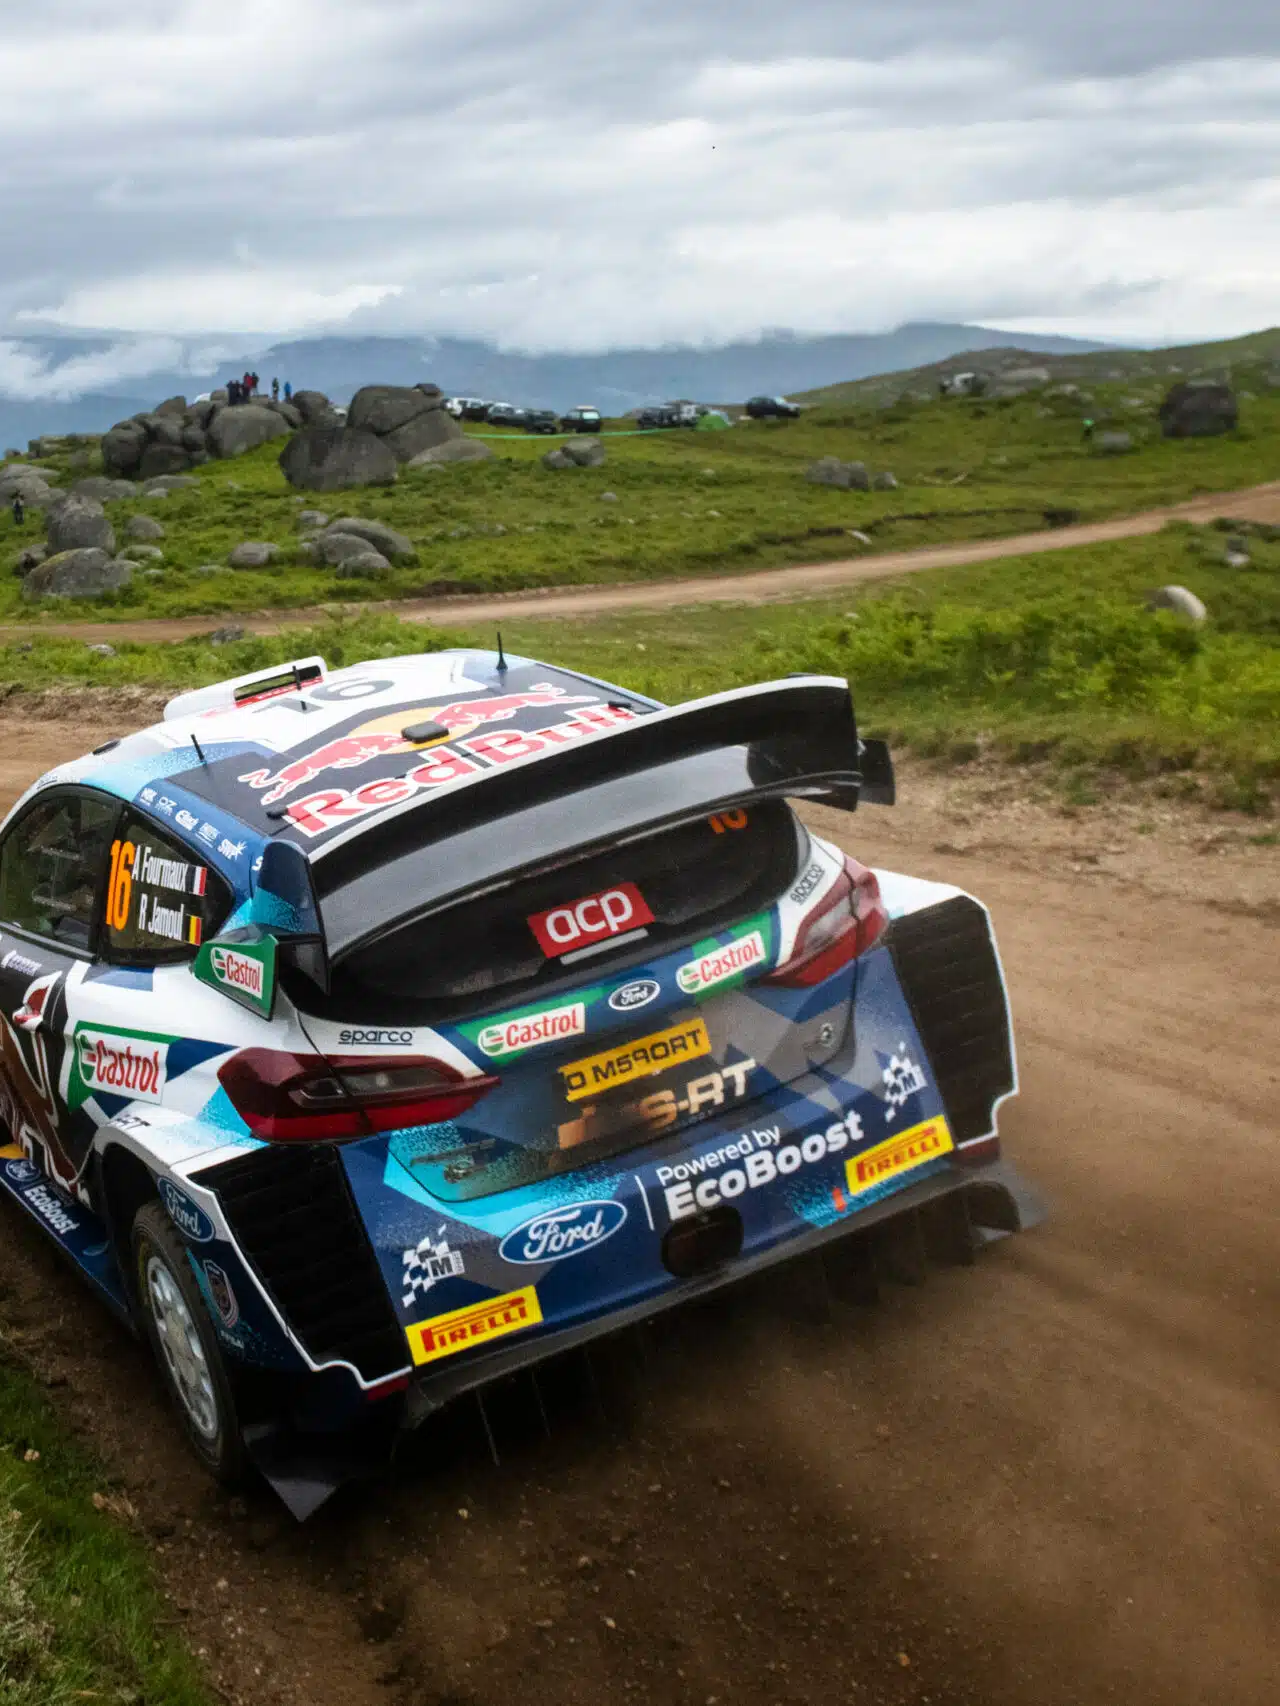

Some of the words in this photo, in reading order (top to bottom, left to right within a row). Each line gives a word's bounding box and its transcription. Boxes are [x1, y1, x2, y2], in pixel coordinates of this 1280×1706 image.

[284, 747, 482, 836] Red
[461, 704, 636, 765] Bull
[106, 839, 136, 931] 16
[132, 845, 141, 881] A
[141, 846, 189, 892] Fourmaux
[790, 864, 825, 905] sparco
[138, 893, 148, 930] R
[148, 897, 185, 941] Jamoul
[546, 891, 633, 943] acp
[227, 954, 261, 992] Castrol
[700, 938, 761, 983] Castrol
[620, 986, 648, 1005] Ford
[338, 1030, 414, 1046] sparco
[506, 1009, 579, 1047] Castrol
[96, 1040, 159, 1094] Castrol
[656, 1134, 756, 1187] Powered
[756, 1125, 781, 1151] by
[664, 1110, 865, 1222] EcoBoost
[856, 1126, 940, 1183] PIRELLI
[23, 1184, 80, 1234] EcoBoost
[164, 1183, 202, 1236] Ford
[523, 1209, 604, 1260] Ford
[420, 1297, 527, 1353] PIRELLI
